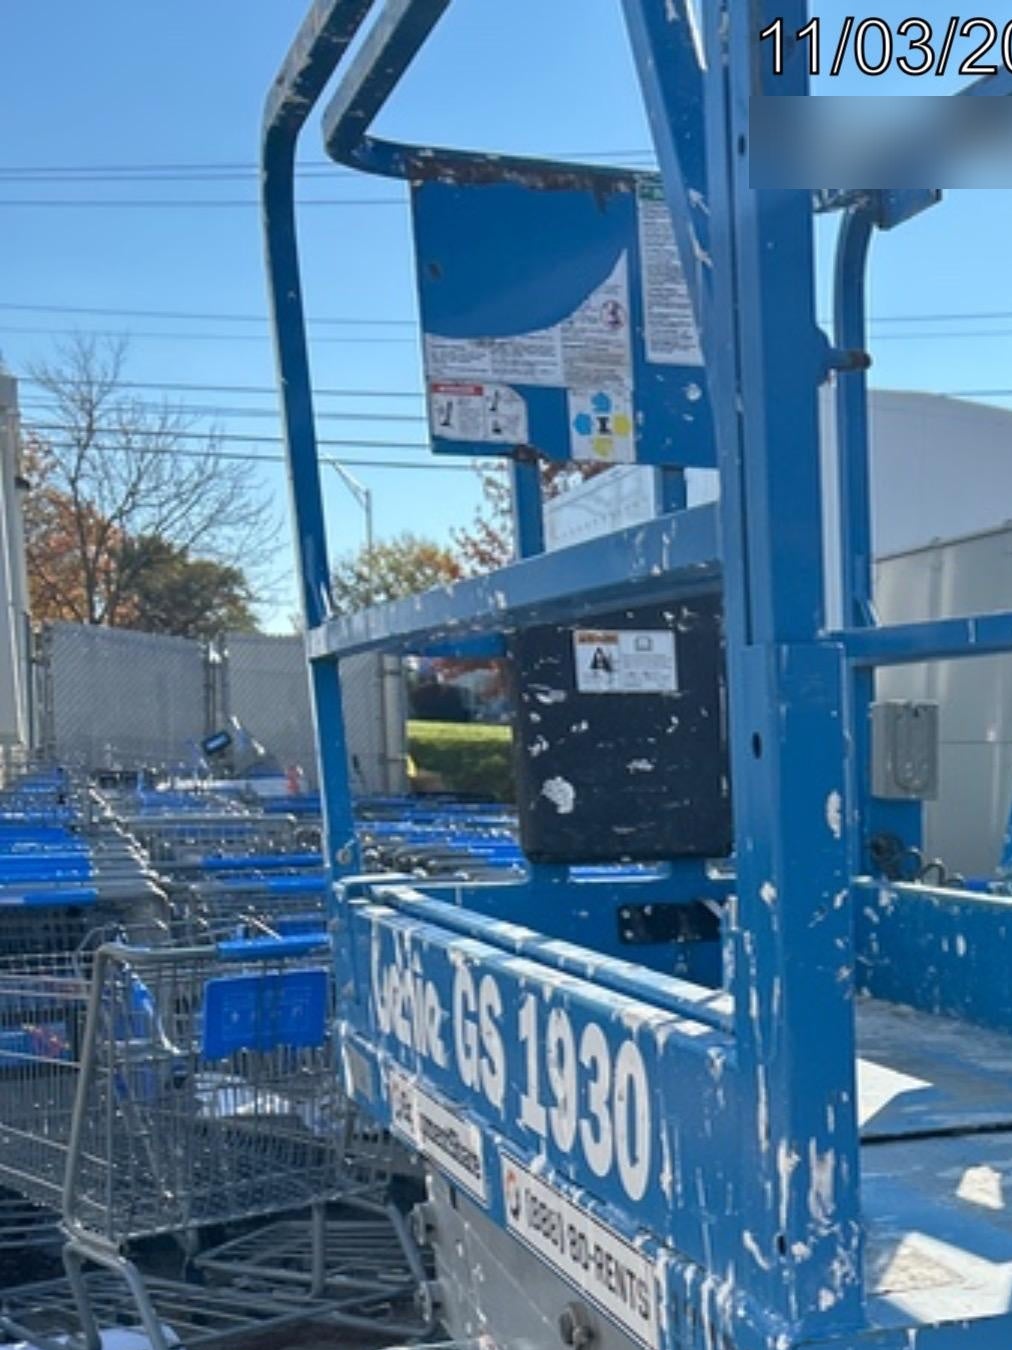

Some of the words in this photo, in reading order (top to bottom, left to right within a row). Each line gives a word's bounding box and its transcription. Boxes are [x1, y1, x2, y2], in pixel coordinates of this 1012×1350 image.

[453, 960, 505, 1110] GS
[518, 993, 651, 1202] 1930
[568, 1222, 651, 1321] 80-RENTS
